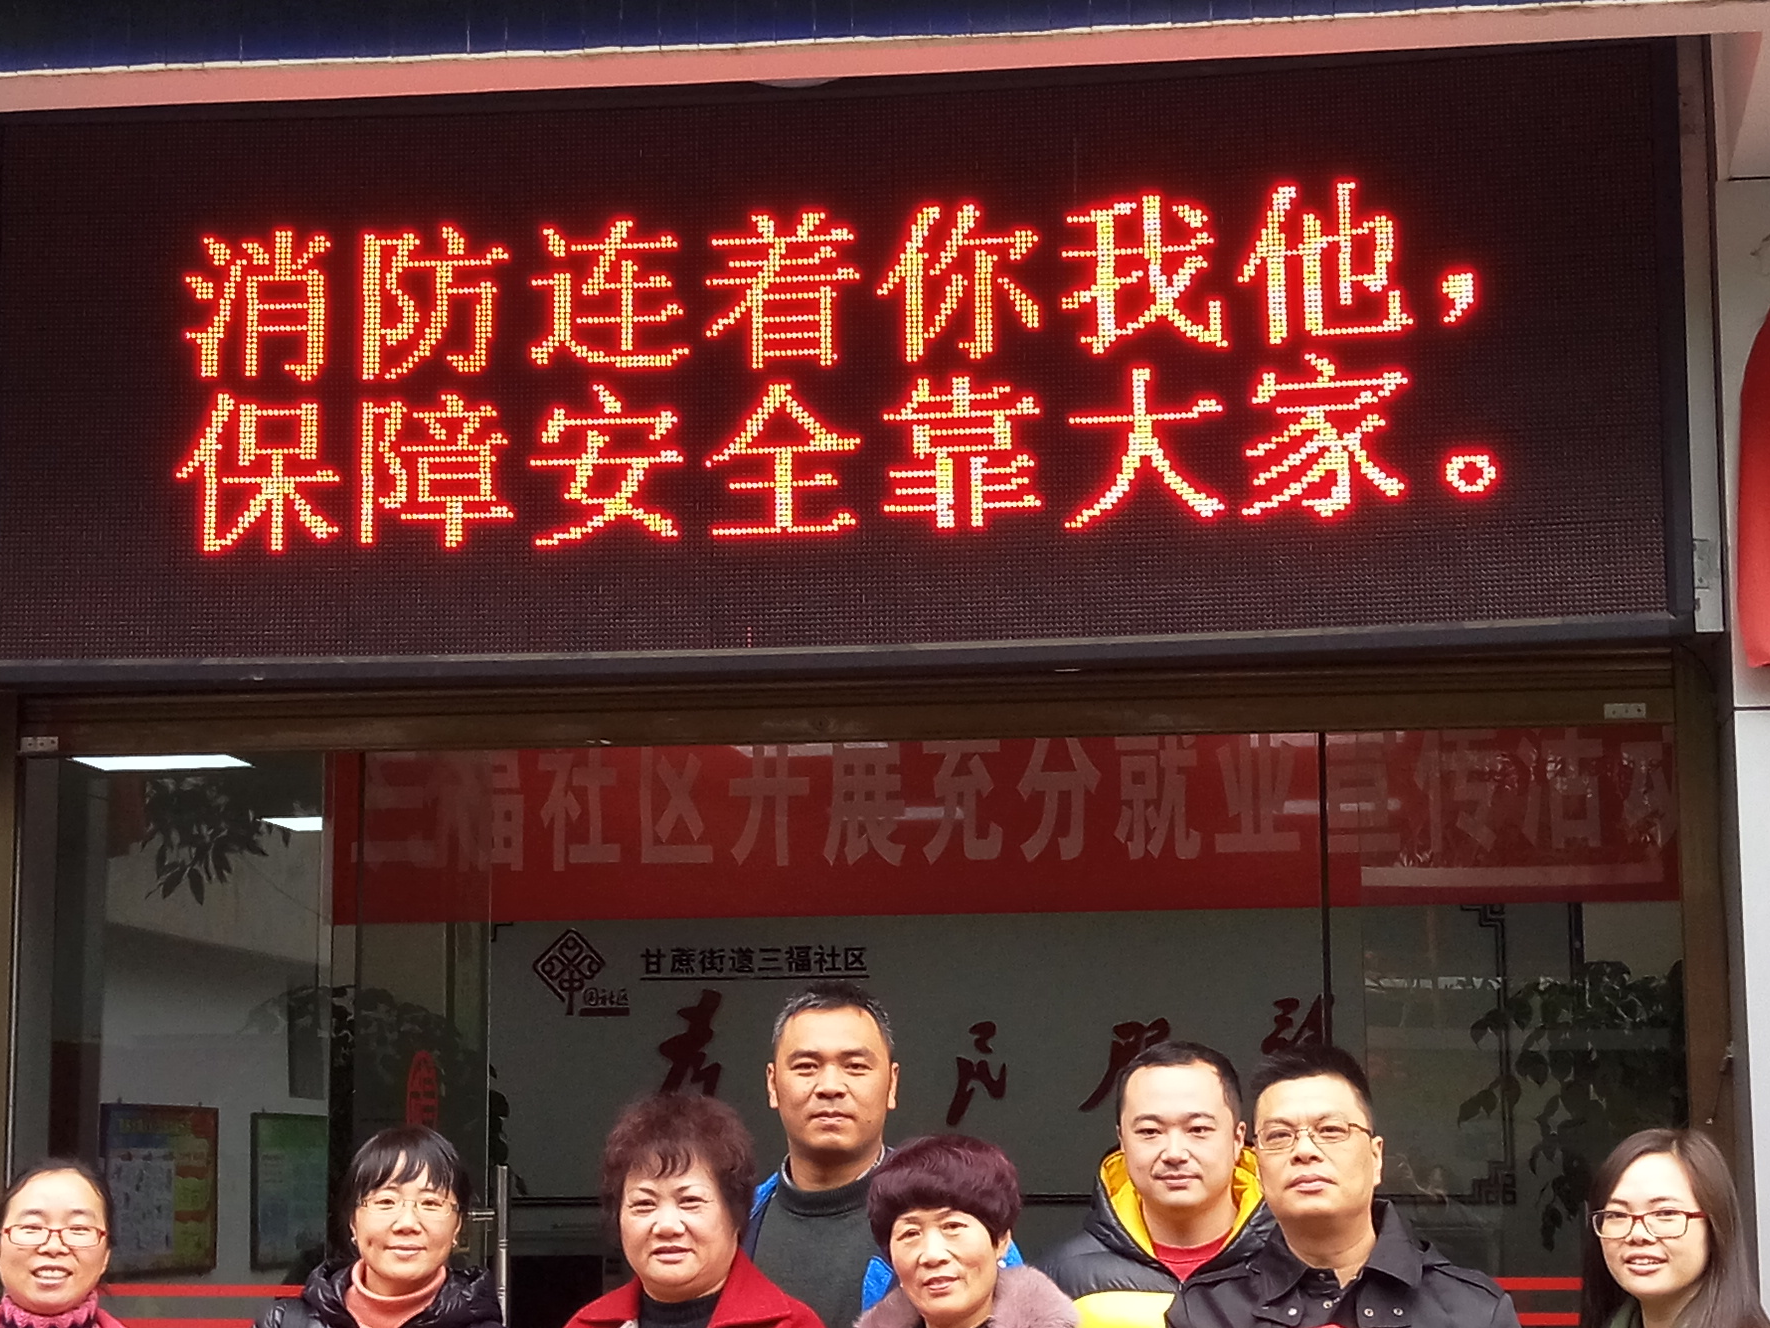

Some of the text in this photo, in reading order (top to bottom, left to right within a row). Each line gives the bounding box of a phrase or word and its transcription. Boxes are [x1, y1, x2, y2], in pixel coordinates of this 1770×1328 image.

[182, 180, 1477, 383] 消防连着你我他，
[176, 353, 1497, 552] 保障安全靠大家。
[640, 945, 868, 974] 甘蔗街道三福社区
